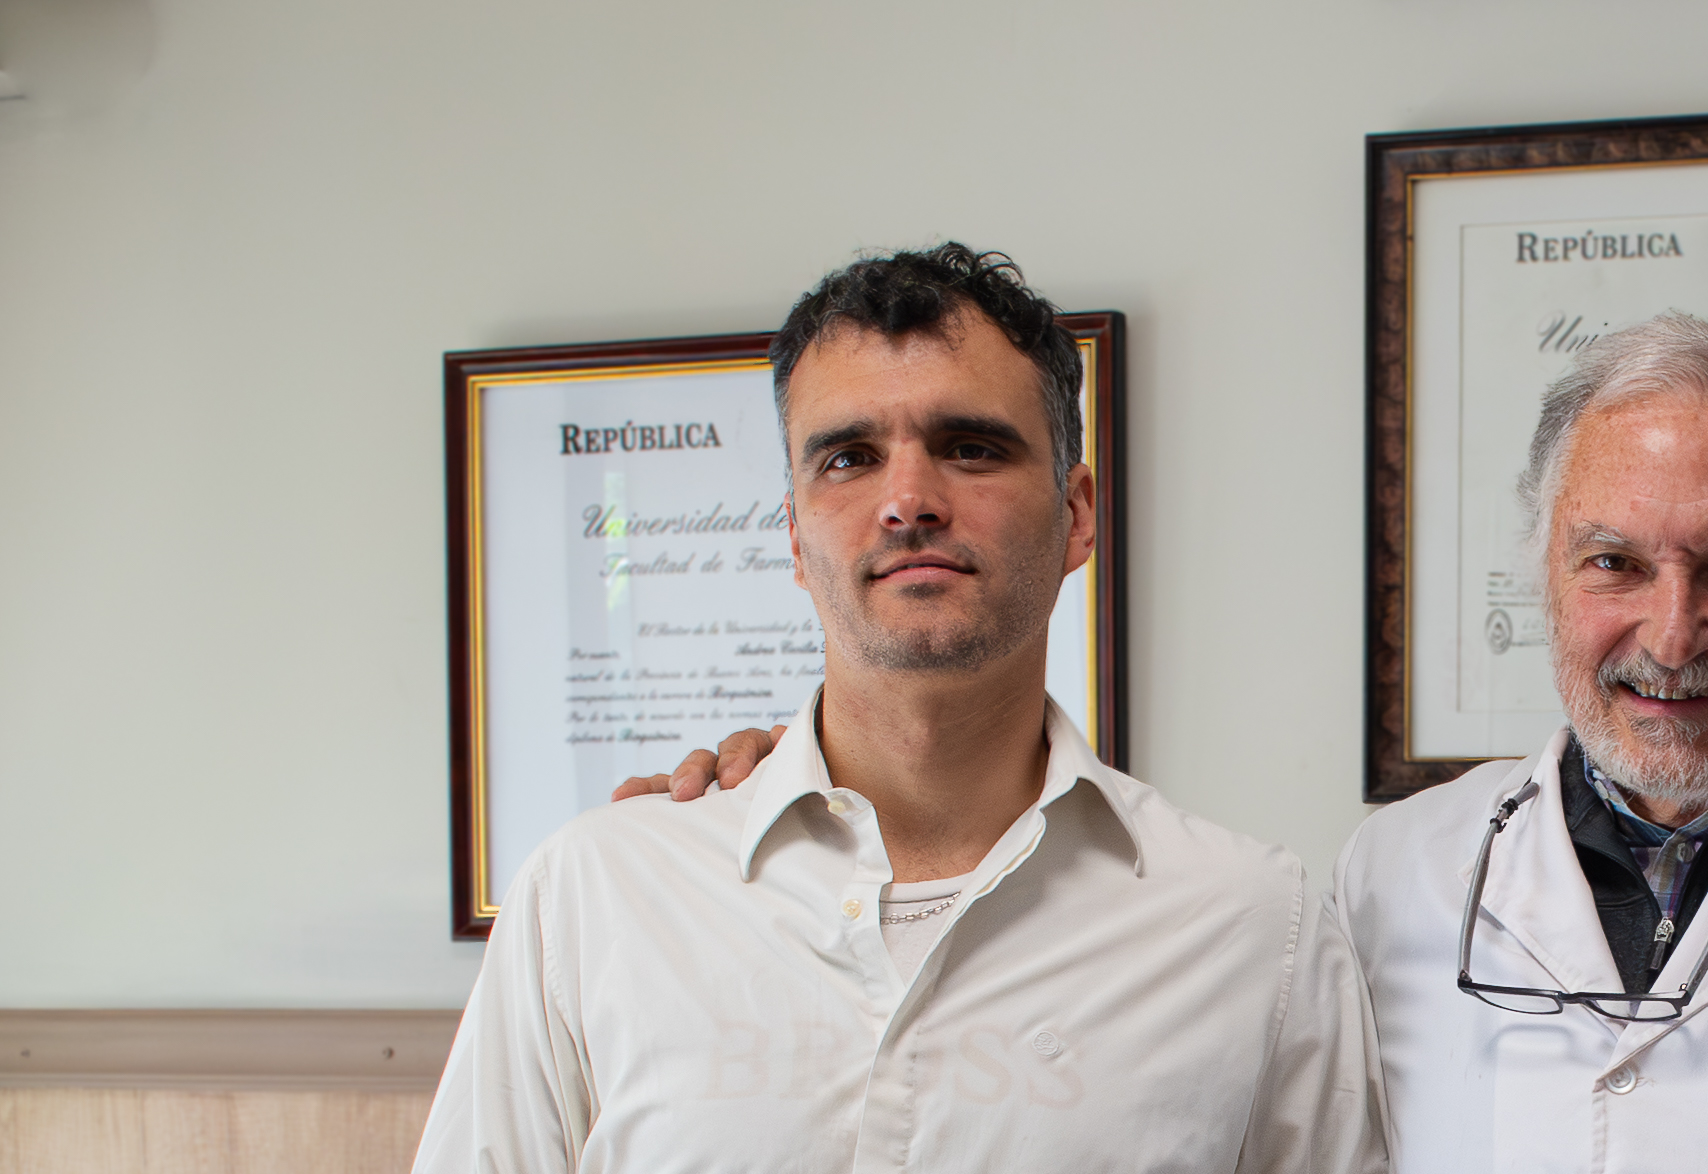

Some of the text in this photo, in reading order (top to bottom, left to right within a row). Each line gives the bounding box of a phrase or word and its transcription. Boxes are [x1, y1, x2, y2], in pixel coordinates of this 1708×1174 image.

[1514, 229, 1684, 264] REPÚBLICA
[559, 420, 723, 455] REPÚBLICA
[582, 501, 760, 540] Universidad
[599, 547, 796, 578] Facultad de Farm
